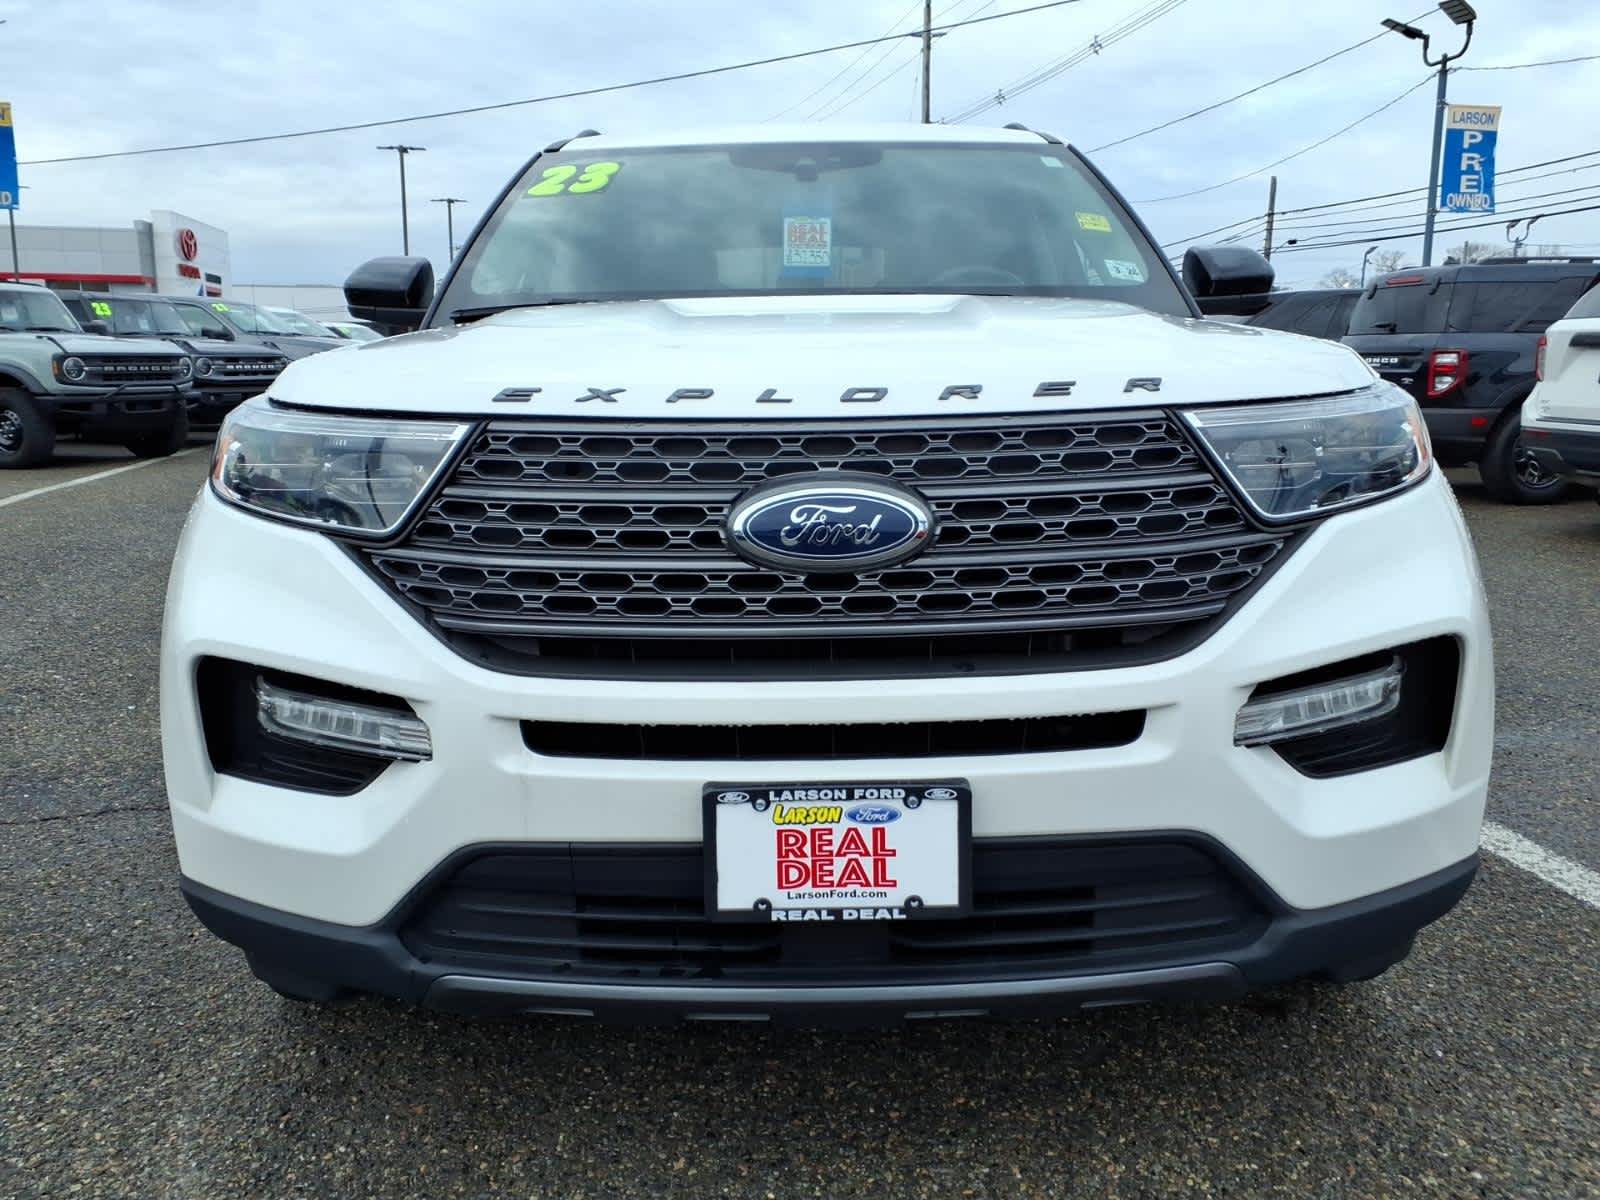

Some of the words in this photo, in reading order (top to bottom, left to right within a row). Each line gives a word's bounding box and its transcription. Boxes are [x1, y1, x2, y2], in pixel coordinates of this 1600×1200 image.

[1452, 112, 1496, 124] LARSON
[526, 161, 621, 197] 23
[1446, 192, 1490, 209] OWNED
[491, 377, 1163, 403] EXPLORER
[780, 504, 883, 546] Ford
[769, 789, 847, 802] LARSON
[854, 788, 906, 801] FORD
[856, 807, 889, 821] Ford
[776, 827, 897, 858] REAL
[776, 857, 898, 890] DEAL
[787, 889, 888, 900] LarsonFord.com
[770, 909, 835, 922] REAL
[843, 908, 907, 921] DEAL
